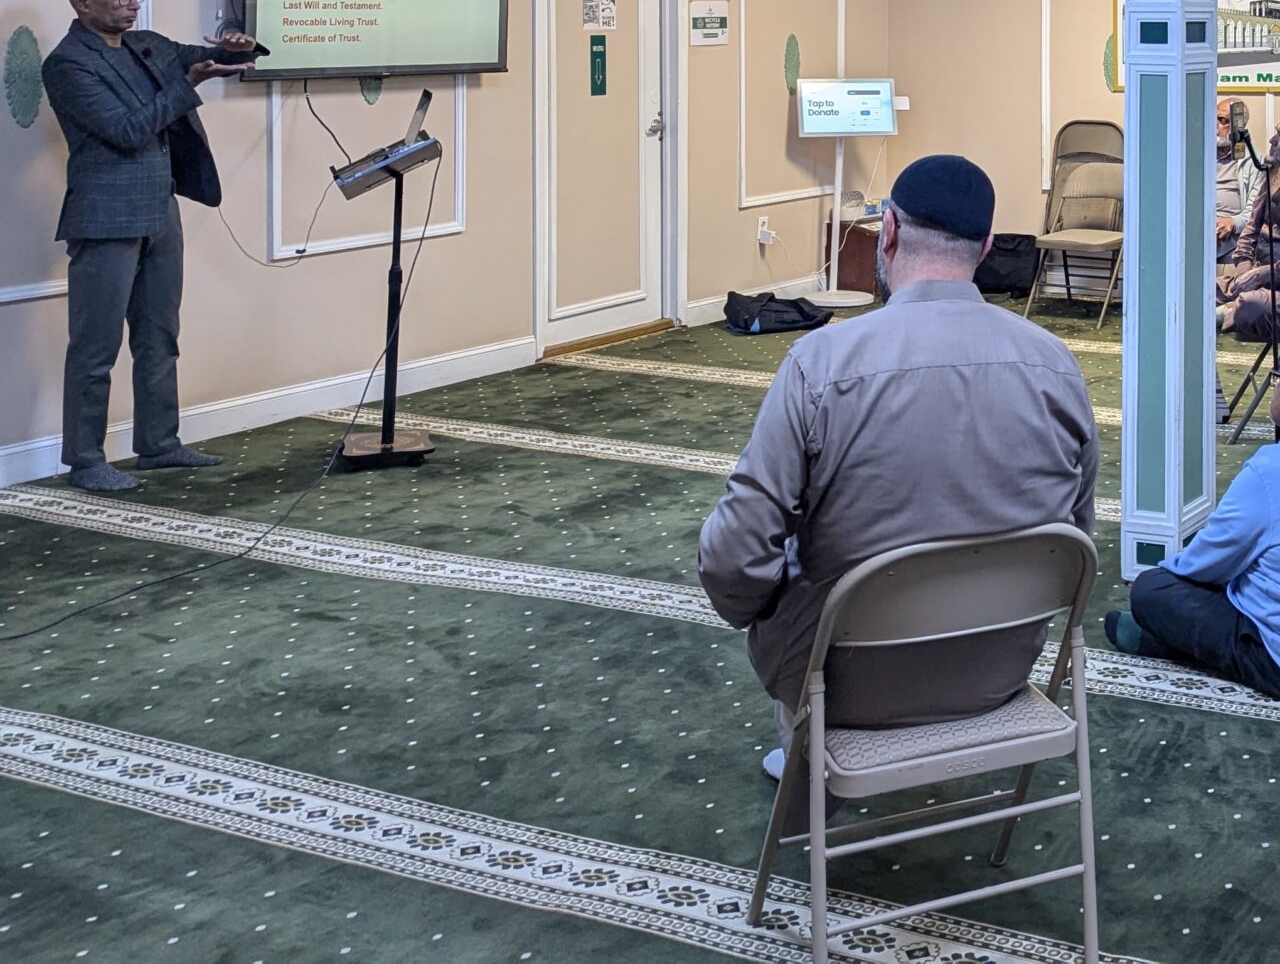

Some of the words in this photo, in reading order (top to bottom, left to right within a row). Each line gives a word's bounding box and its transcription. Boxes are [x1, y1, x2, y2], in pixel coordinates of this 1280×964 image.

[283, 1, 302, 9] Last
[304, 1, 320, 9] Will
[322, 2, 338, 10] and
[340, 1, 383, 10] Testament.
[283, 18, 327, 26] Revocable
[330, 18, 355, 27] Living
[357, 18, 379, 26] Trust.
[282, 35, 325, 43] Certificate
[328, 34, 336, 42] of
[339, 34, 361, 42] Trust.
[807, 100, 824, 109] Tap
